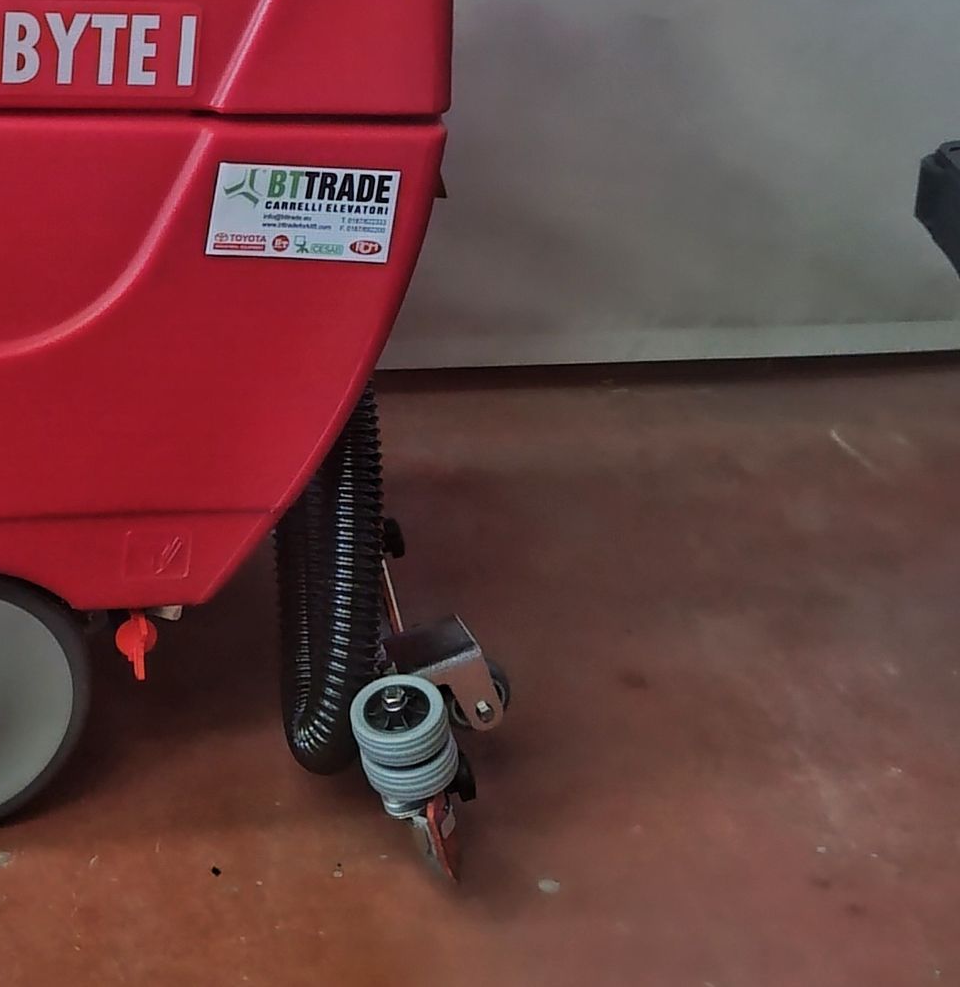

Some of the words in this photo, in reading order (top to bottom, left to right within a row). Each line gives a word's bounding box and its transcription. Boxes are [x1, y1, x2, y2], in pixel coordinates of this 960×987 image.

[1, 11, 161, 86] BYTE
[177, 16, 197, 86] I
[267, 169, 393, 204] BTTRADE
[265, 201, 321, 211] CARRELLI
[326, 203, 388, 215] ELEVATORI
[230, 234, 267, 242] TOYOTA
